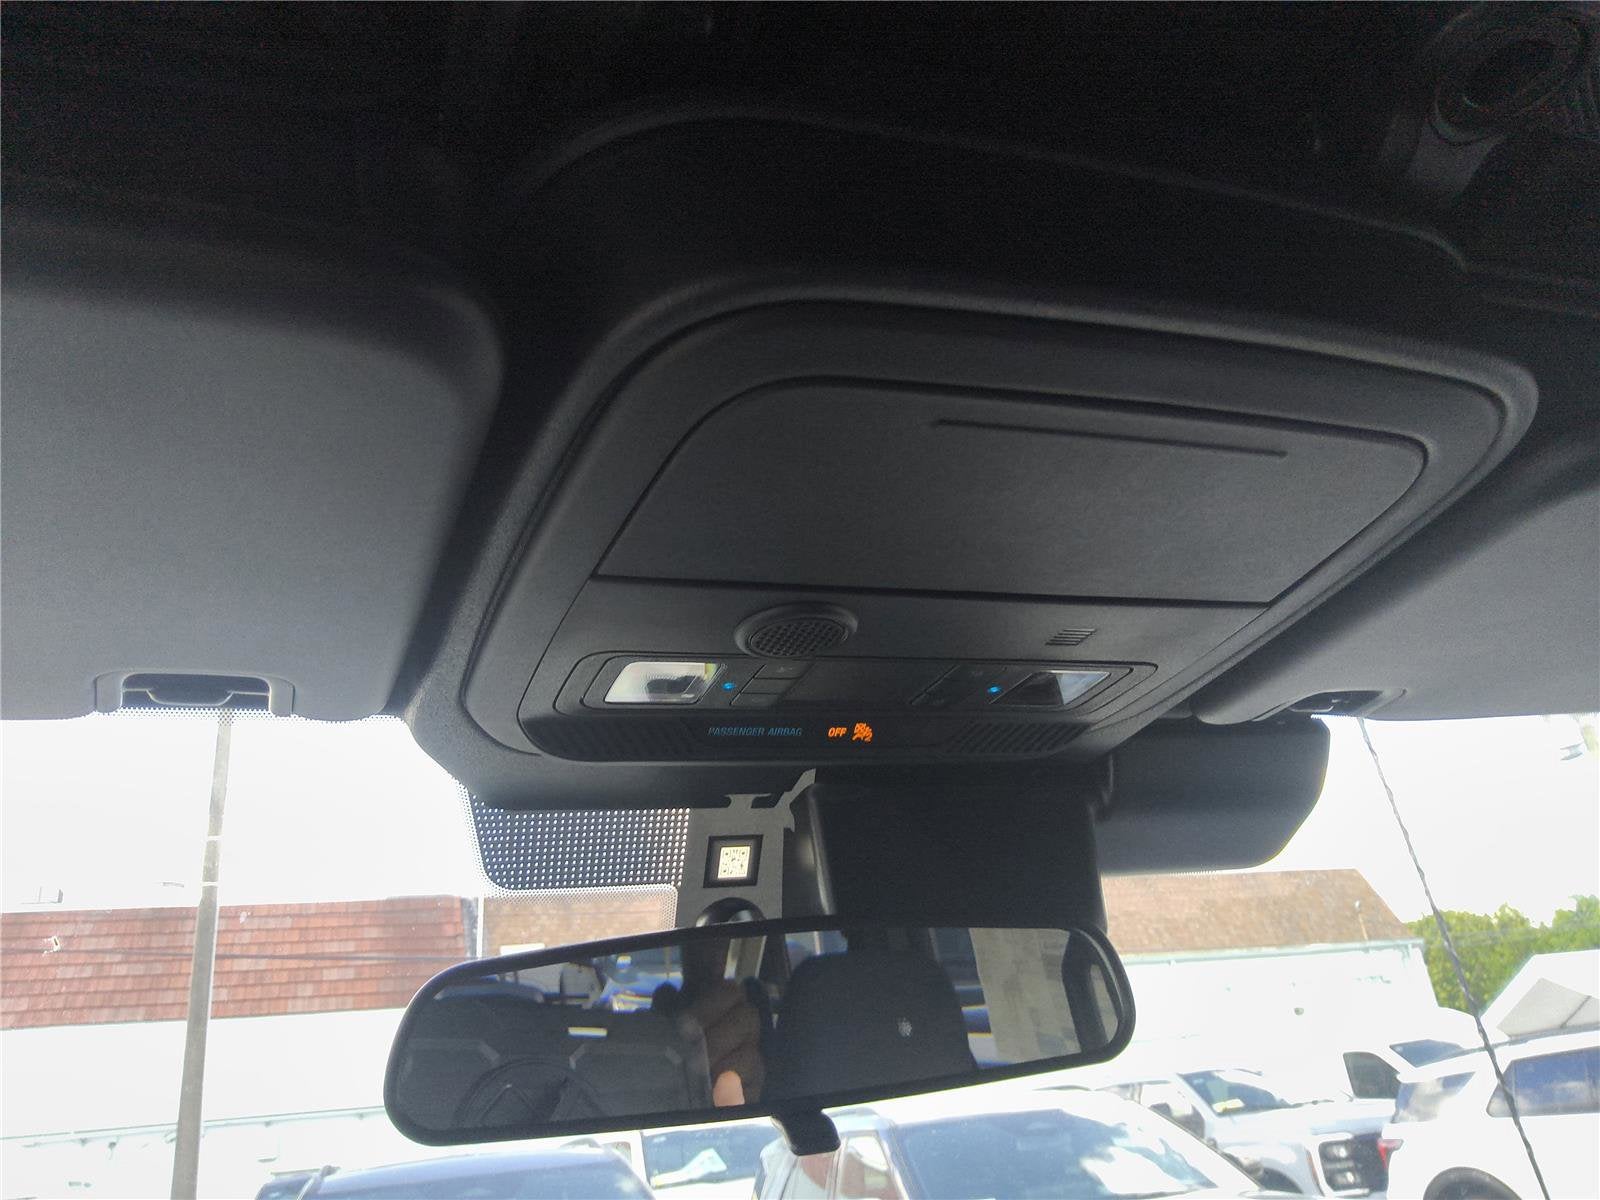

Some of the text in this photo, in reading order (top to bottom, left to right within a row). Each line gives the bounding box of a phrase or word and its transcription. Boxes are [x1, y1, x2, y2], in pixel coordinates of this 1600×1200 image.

[708, 726, 847, 737] PASSENGER AIRBAG OFF
